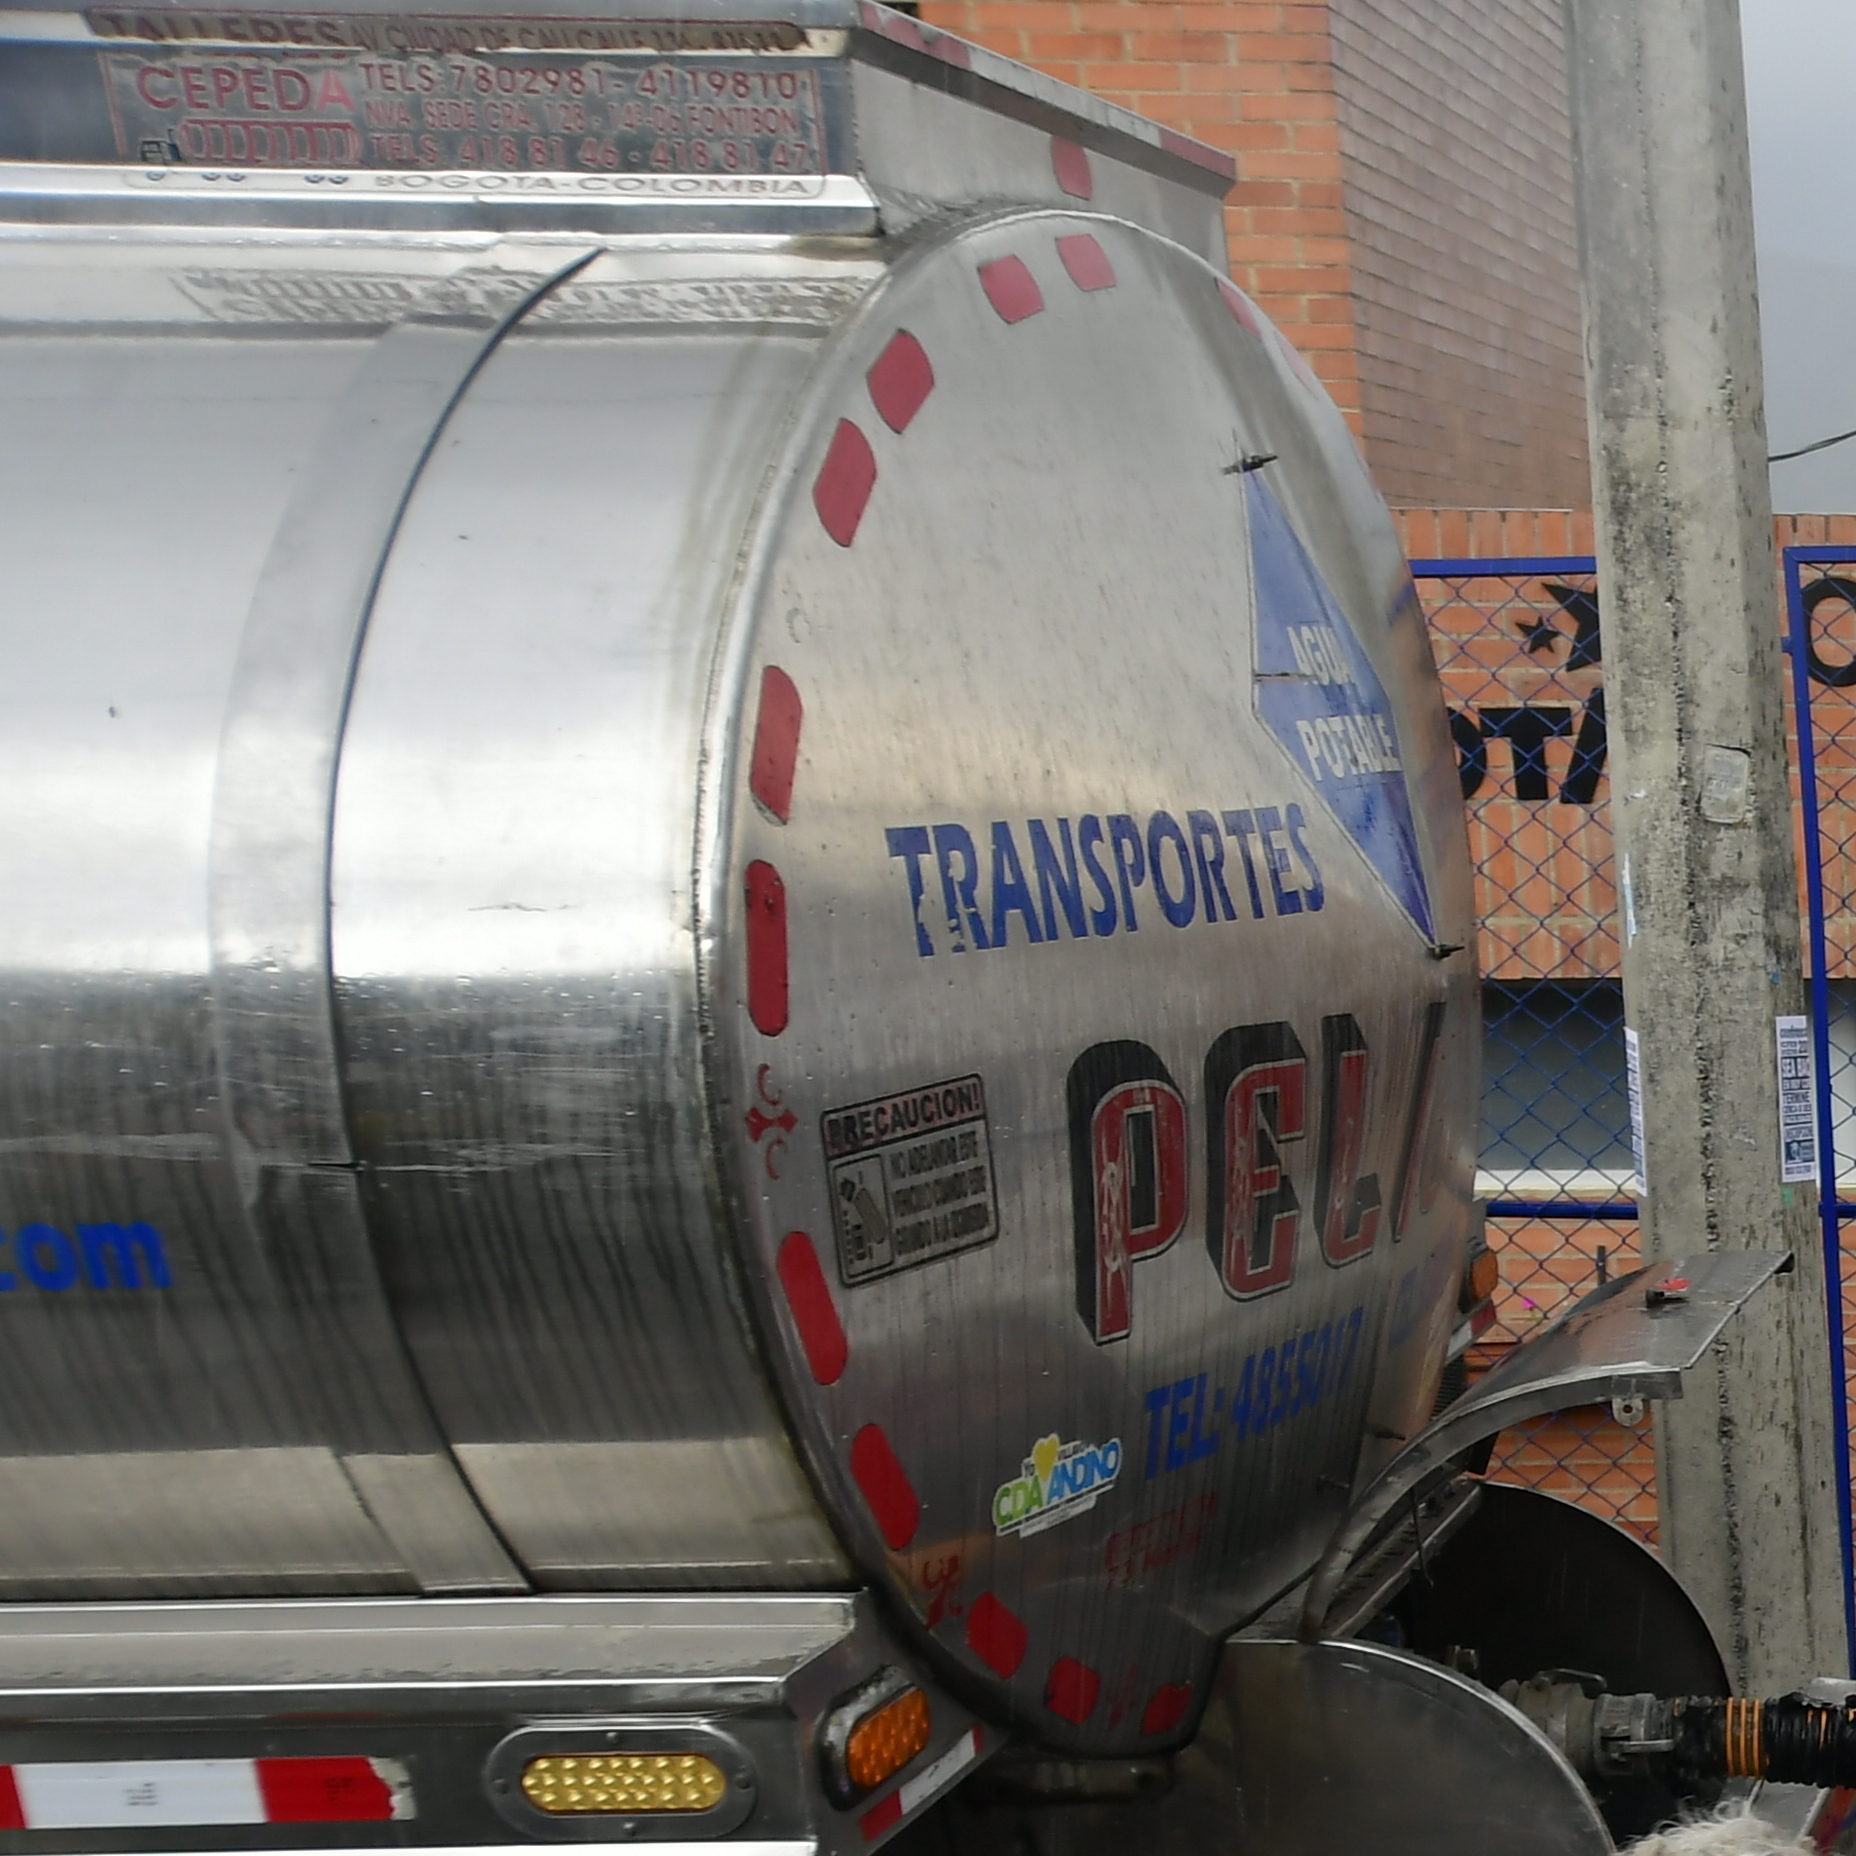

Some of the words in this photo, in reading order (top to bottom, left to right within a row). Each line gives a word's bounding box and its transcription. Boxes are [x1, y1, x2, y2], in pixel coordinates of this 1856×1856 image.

[136, 65, 356, 112] CEPEDA
[639, 69, 798, 100] 4119810
[460, 137, 519, 165] 418
[652, 140, 709, 169] 418
[1296, 712, 1403, 783] POTABLE
[884, 802, 1326, 958] TRANSPORTES
[827, 1082, 982, 1150] PRECAUCION!
[995, 1475, 1043, 1527] CDA
[1046, 1441, 1120, 1506] ANDINO
